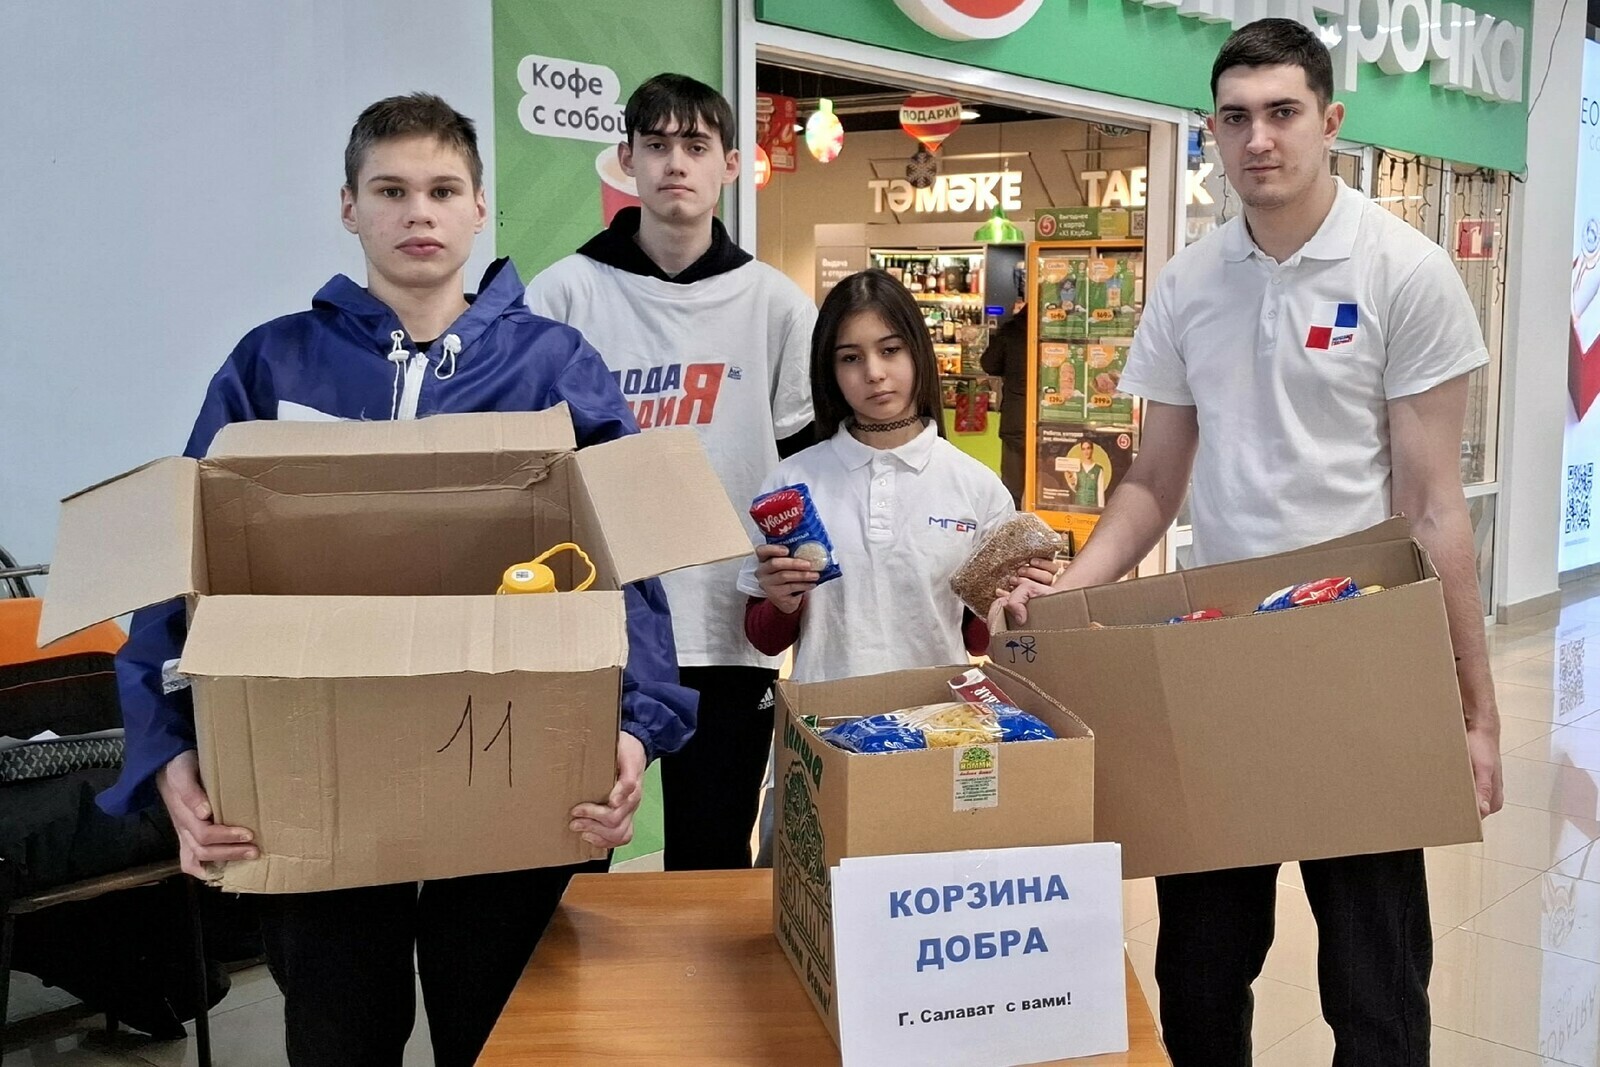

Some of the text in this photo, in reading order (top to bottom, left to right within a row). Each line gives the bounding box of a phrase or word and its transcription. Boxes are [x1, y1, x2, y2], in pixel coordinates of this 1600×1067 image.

[532, 62, 603, 98] Кофе
[533, 105, 546, 124] с
[903, 106, 959, 122] ПОДАРКИ
[868, 171, 1022, 213] ТӘМӘКЕ
[760, 506, 799, 532] Увелка
[890, 874, 1070, 919] КОРЗИНА
[916, 926, 1049, 972] ДОБРА
[898, 992, 1072, 1026] Г. Салават с вами!
